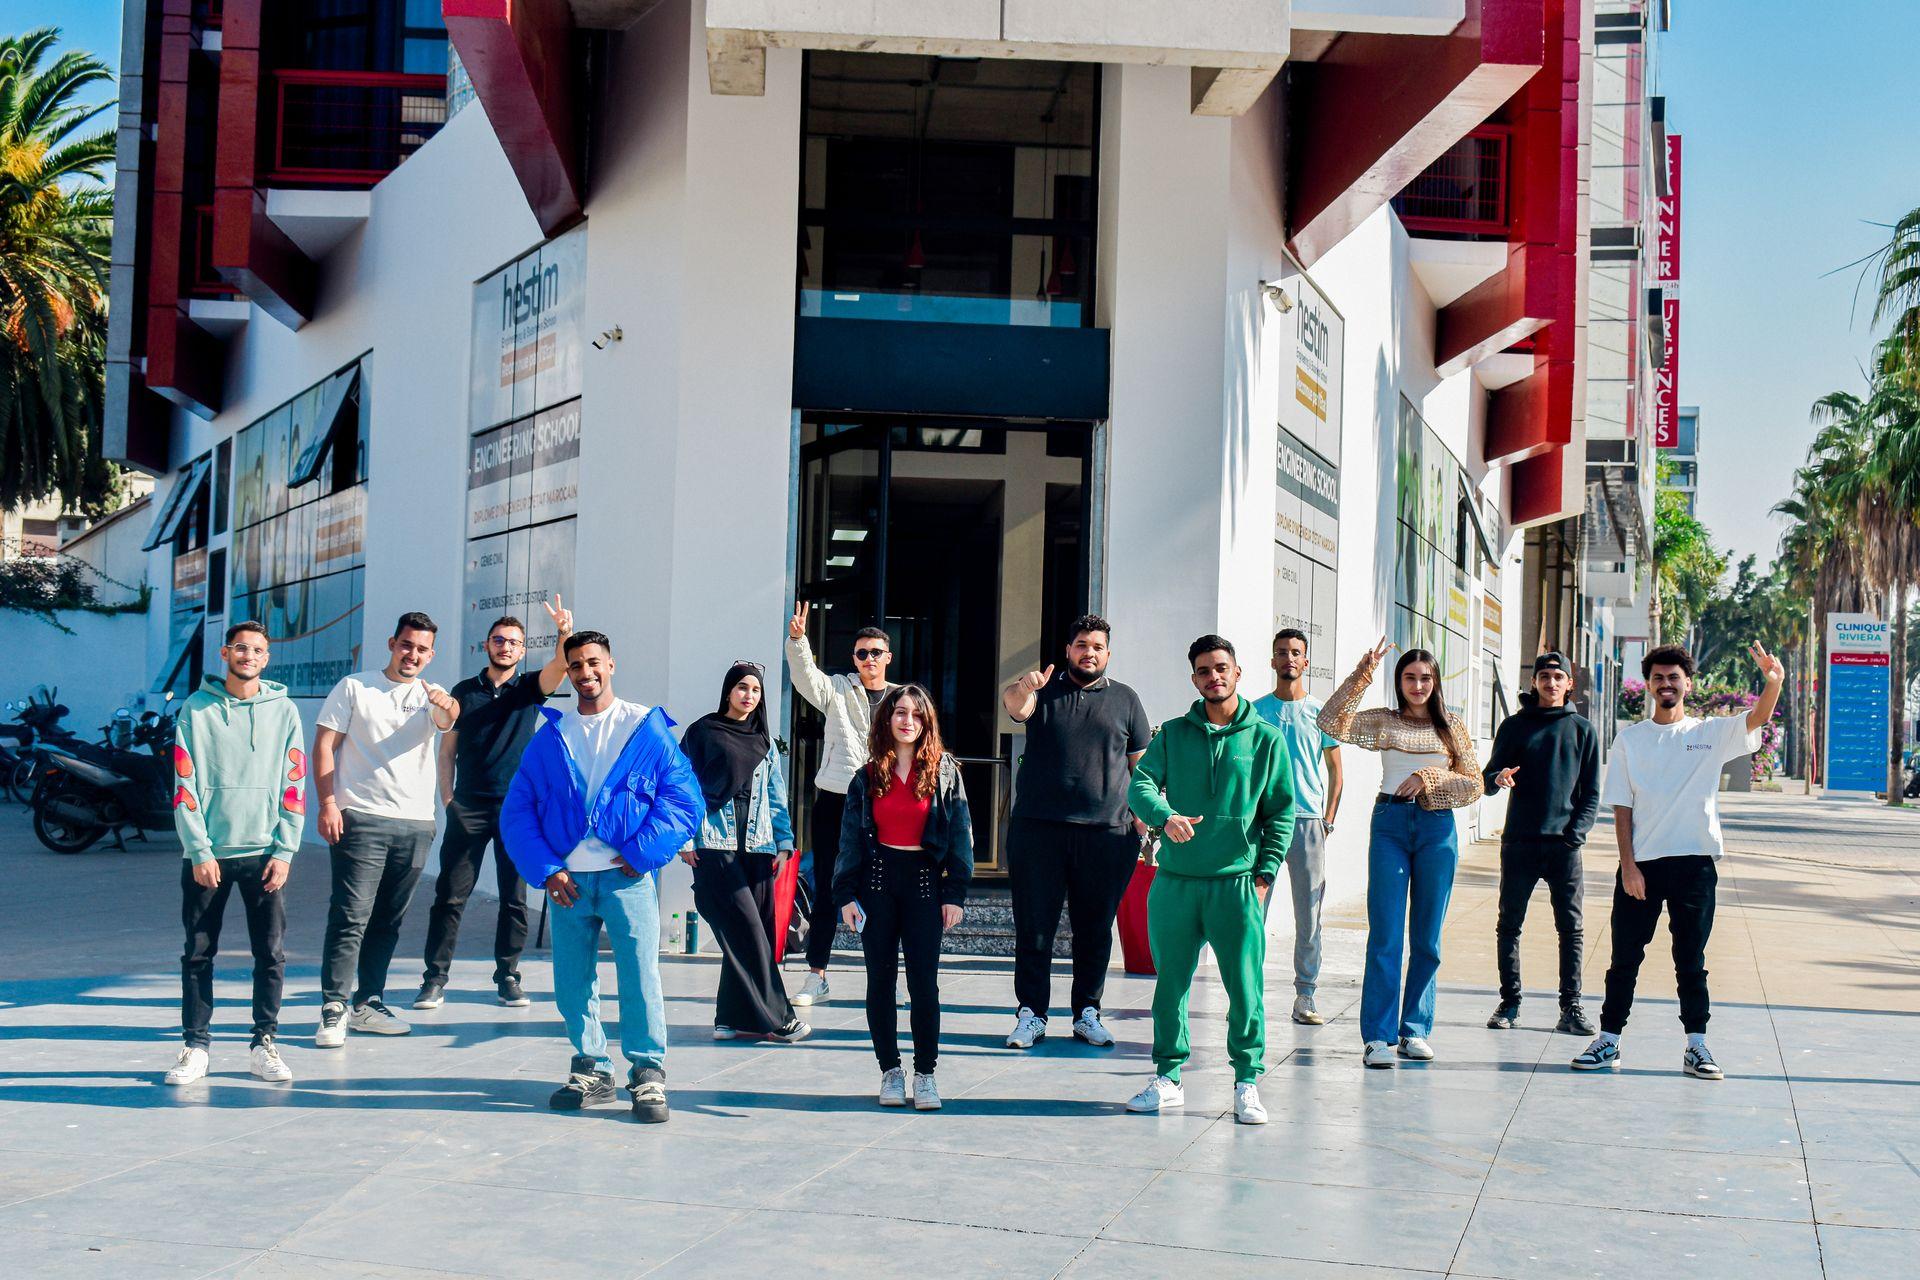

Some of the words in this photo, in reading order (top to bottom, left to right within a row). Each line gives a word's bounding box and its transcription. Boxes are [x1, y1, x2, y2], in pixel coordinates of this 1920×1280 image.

[1659, 138, 1674, 277] SNNER
[502, 263, 558, 331] hestim
[1296, 280, 1329, 367] hestim
[474, 429, 535, 473] ENGINEERING
[538, 412, 581, 451] SCHOOL
[1277, 440, 1317, 493] ENGINEERING
[1317, 469, 1338, 505] SCHOOL
[1836, 623, 1887, 632] CLINIQUE
[1839, 633, 1882, 641] RIVIERA
